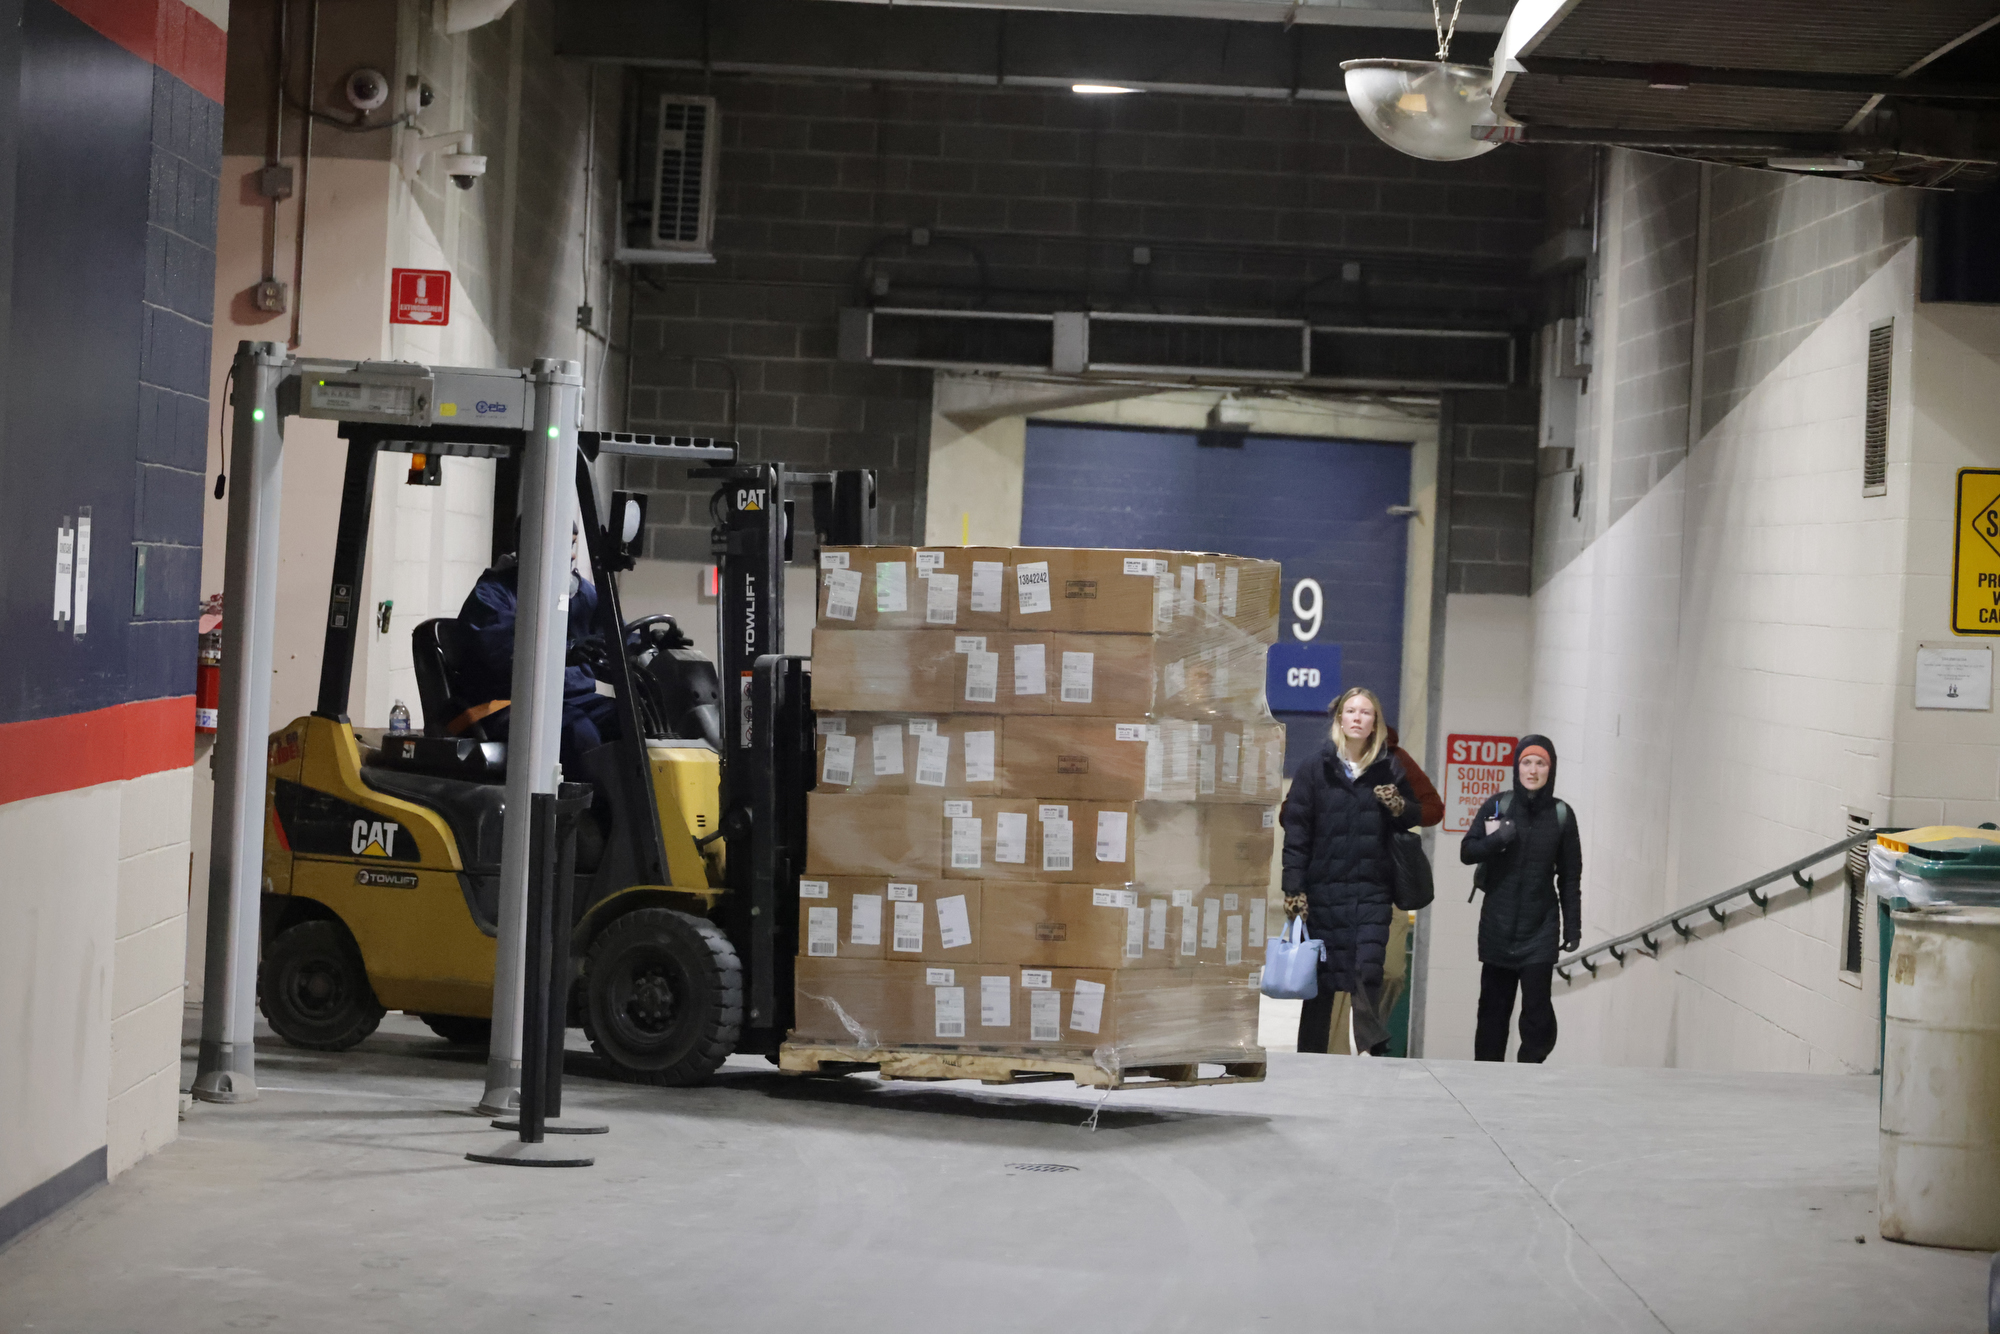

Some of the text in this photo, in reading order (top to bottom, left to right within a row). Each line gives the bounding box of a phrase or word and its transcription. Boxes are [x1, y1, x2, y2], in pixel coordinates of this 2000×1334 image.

[736, 489, 766, 511] CAT
[1986, 510, 2000, 537] S
[1018, 572, 1048, 586] 13842242
[745, 573, 756, 656] TOWLIFT
[1292, 578, 1324, 641] 9
[1979, 608, 2000, 624] CA
[1286, 667, 1321, 688] CFD
[1452, 739, 1512, 762] STOP
[1457, 767, 1505, 782] SOUND
[1461, 782, 1500, 795] HORN
[1458, 796, 1488, 806] PROC
[351, 819, 399, 857] CAT
[369, 873, 418, 886] TOWLIFT
